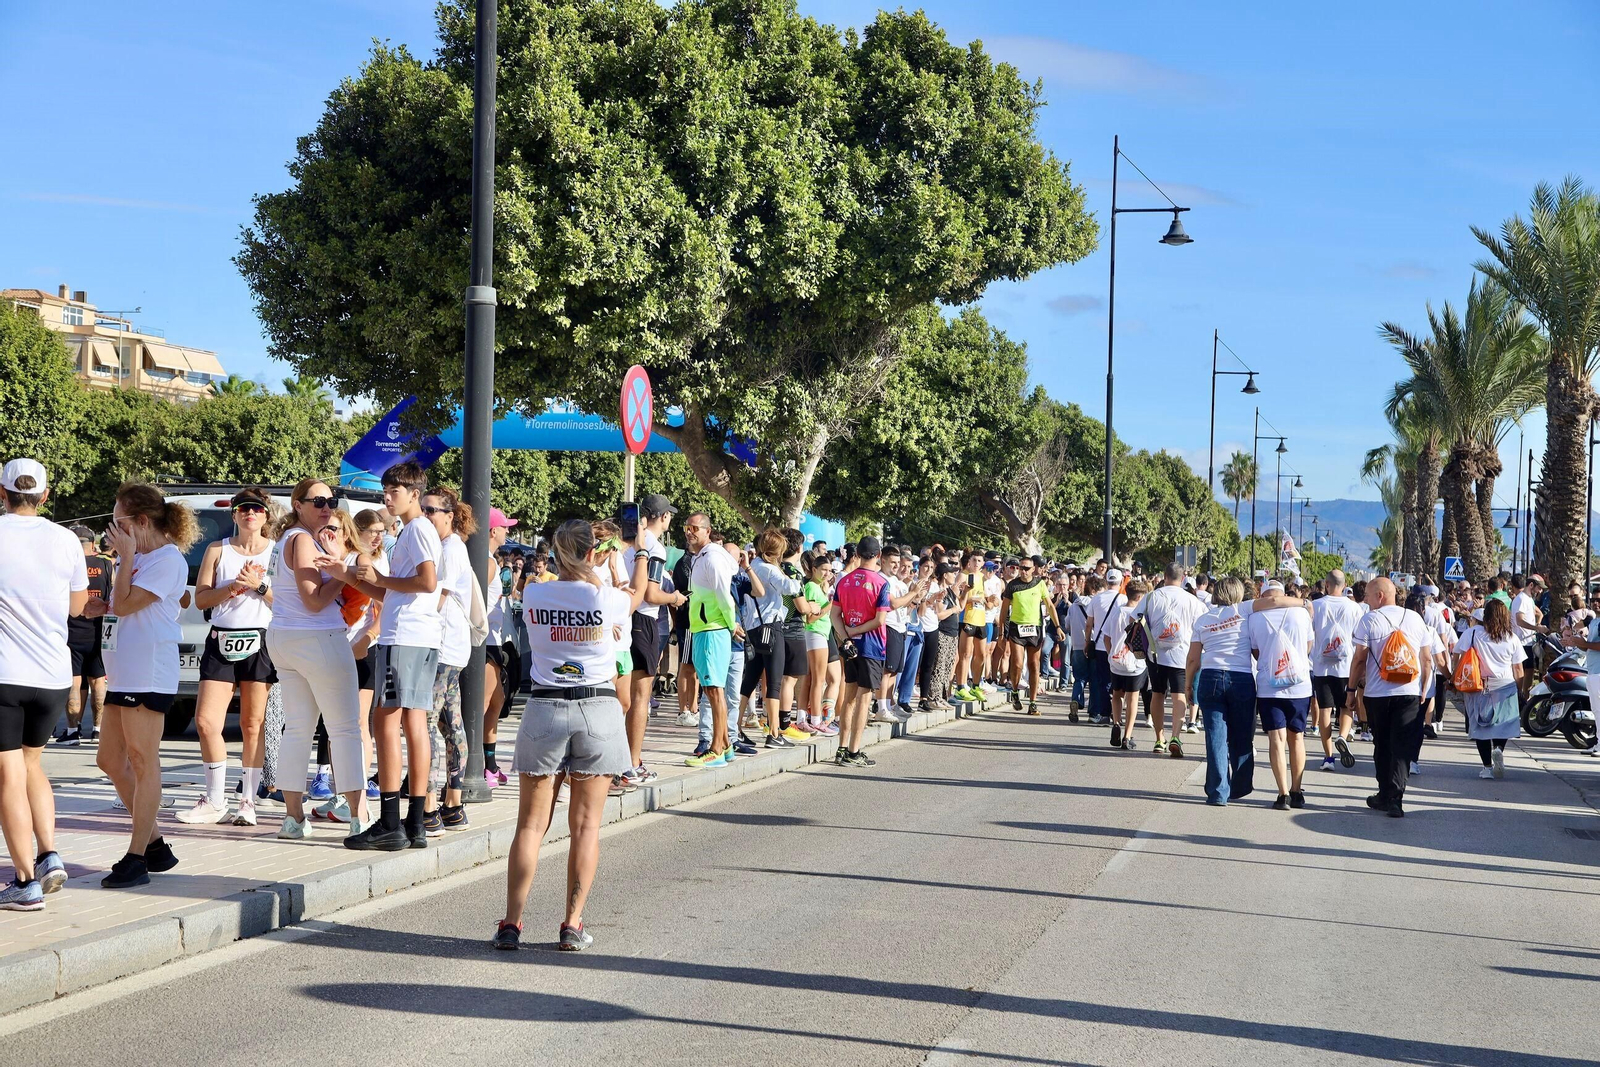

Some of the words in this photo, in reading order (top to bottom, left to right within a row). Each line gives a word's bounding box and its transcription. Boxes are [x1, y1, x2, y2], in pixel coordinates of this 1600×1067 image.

[525, 420, 621, 432] #TorremolinosesDep
[550, 626, 603, 642] amazonas
[224, 638, 256, 652] 507
